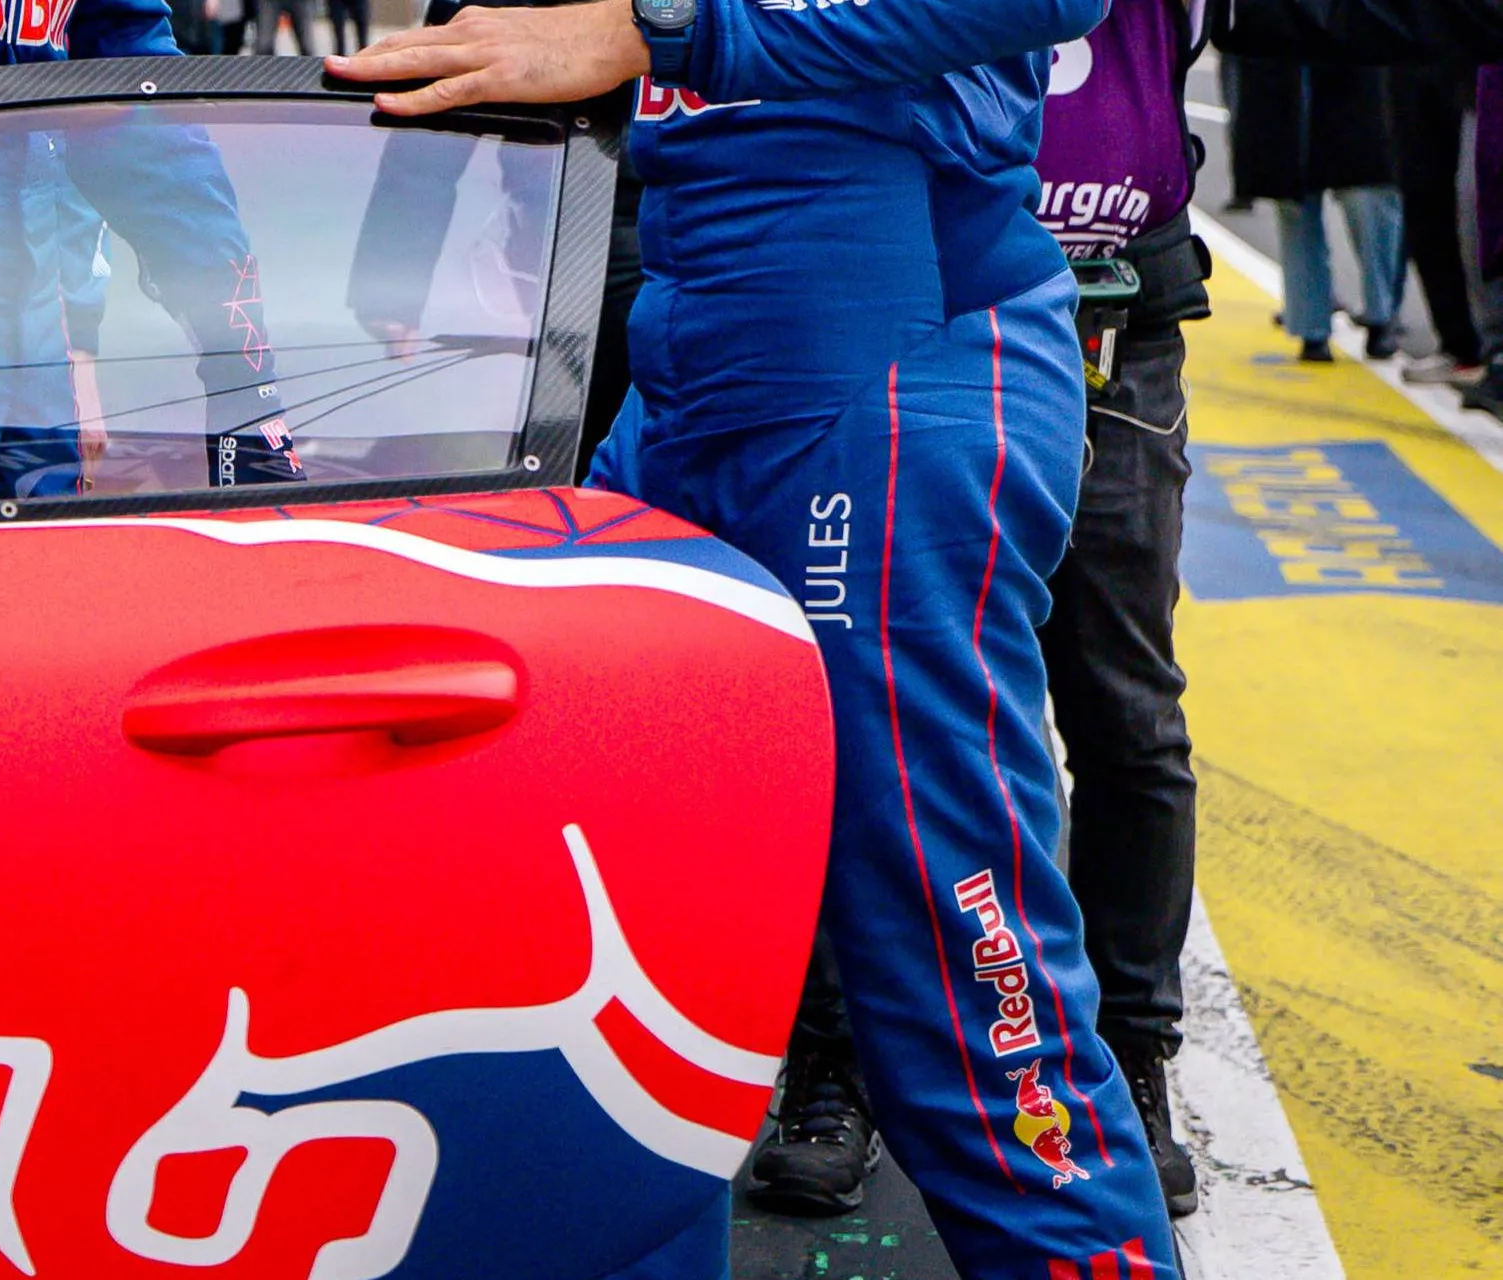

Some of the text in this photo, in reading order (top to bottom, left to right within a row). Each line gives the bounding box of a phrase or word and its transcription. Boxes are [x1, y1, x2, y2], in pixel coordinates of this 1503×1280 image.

[805, 492, 853, 629] JULES
[953, 868, 1042, 1058] Red Bull
